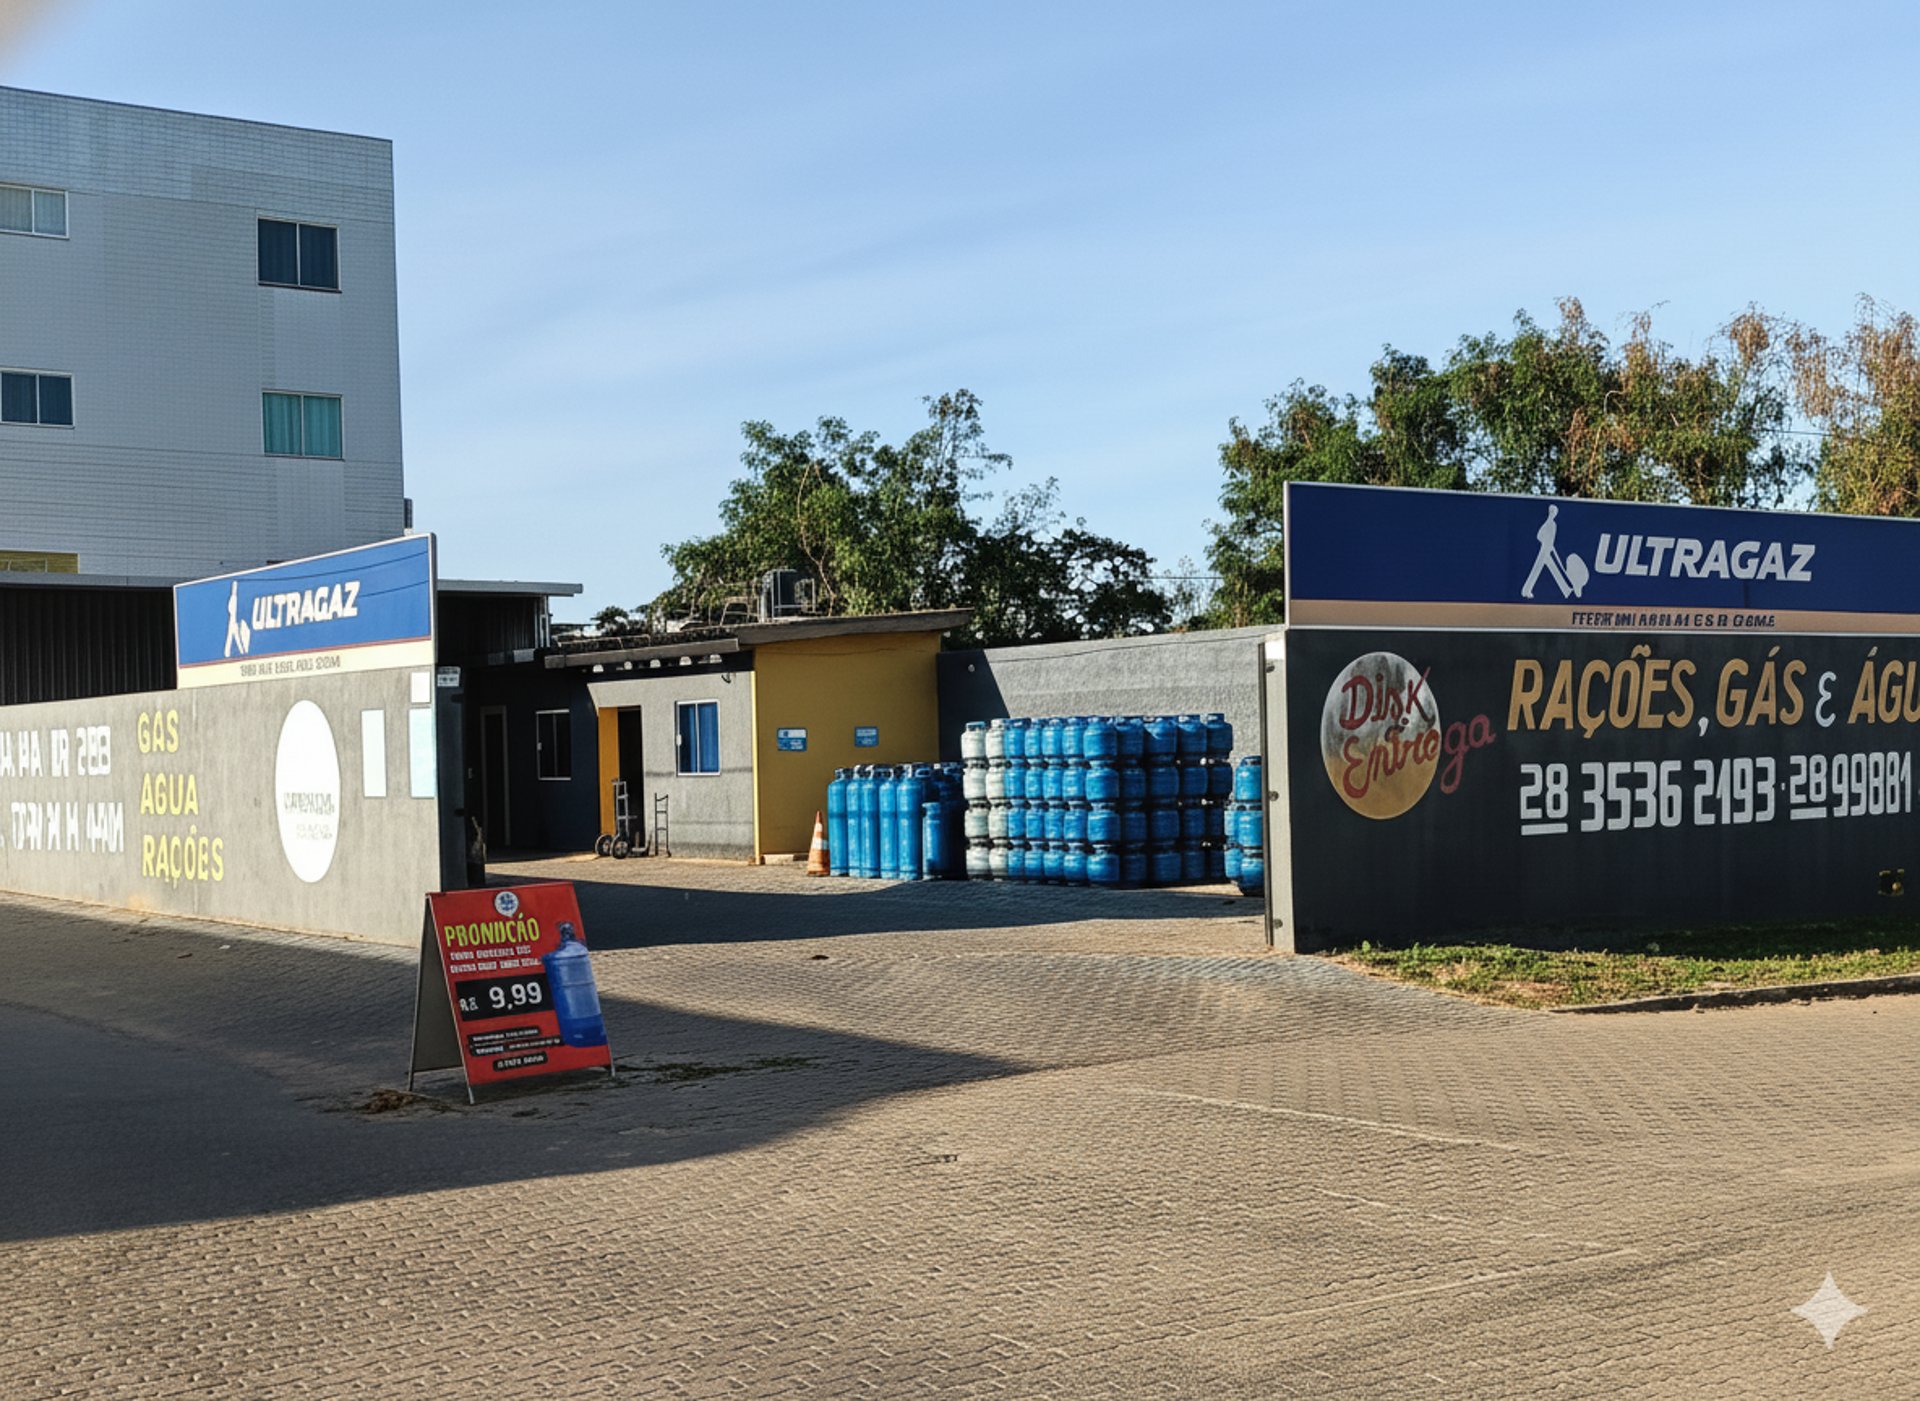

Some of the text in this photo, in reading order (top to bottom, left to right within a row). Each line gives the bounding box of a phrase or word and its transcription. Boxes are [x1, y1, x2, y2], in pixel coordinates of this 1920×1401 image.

[1594, 532, 1816, 582] ULTRAGAZ
[252, 580, 361, 631] ULTRAGAZ
[1716, 645, 1807, 728] GÁS
[137, 709, 180, 754] GAS
[140, 772, 199, 816] AGUA
[1580, 759, 1683, 833] 3536
[488, 981, 543, 1010] 9,99
